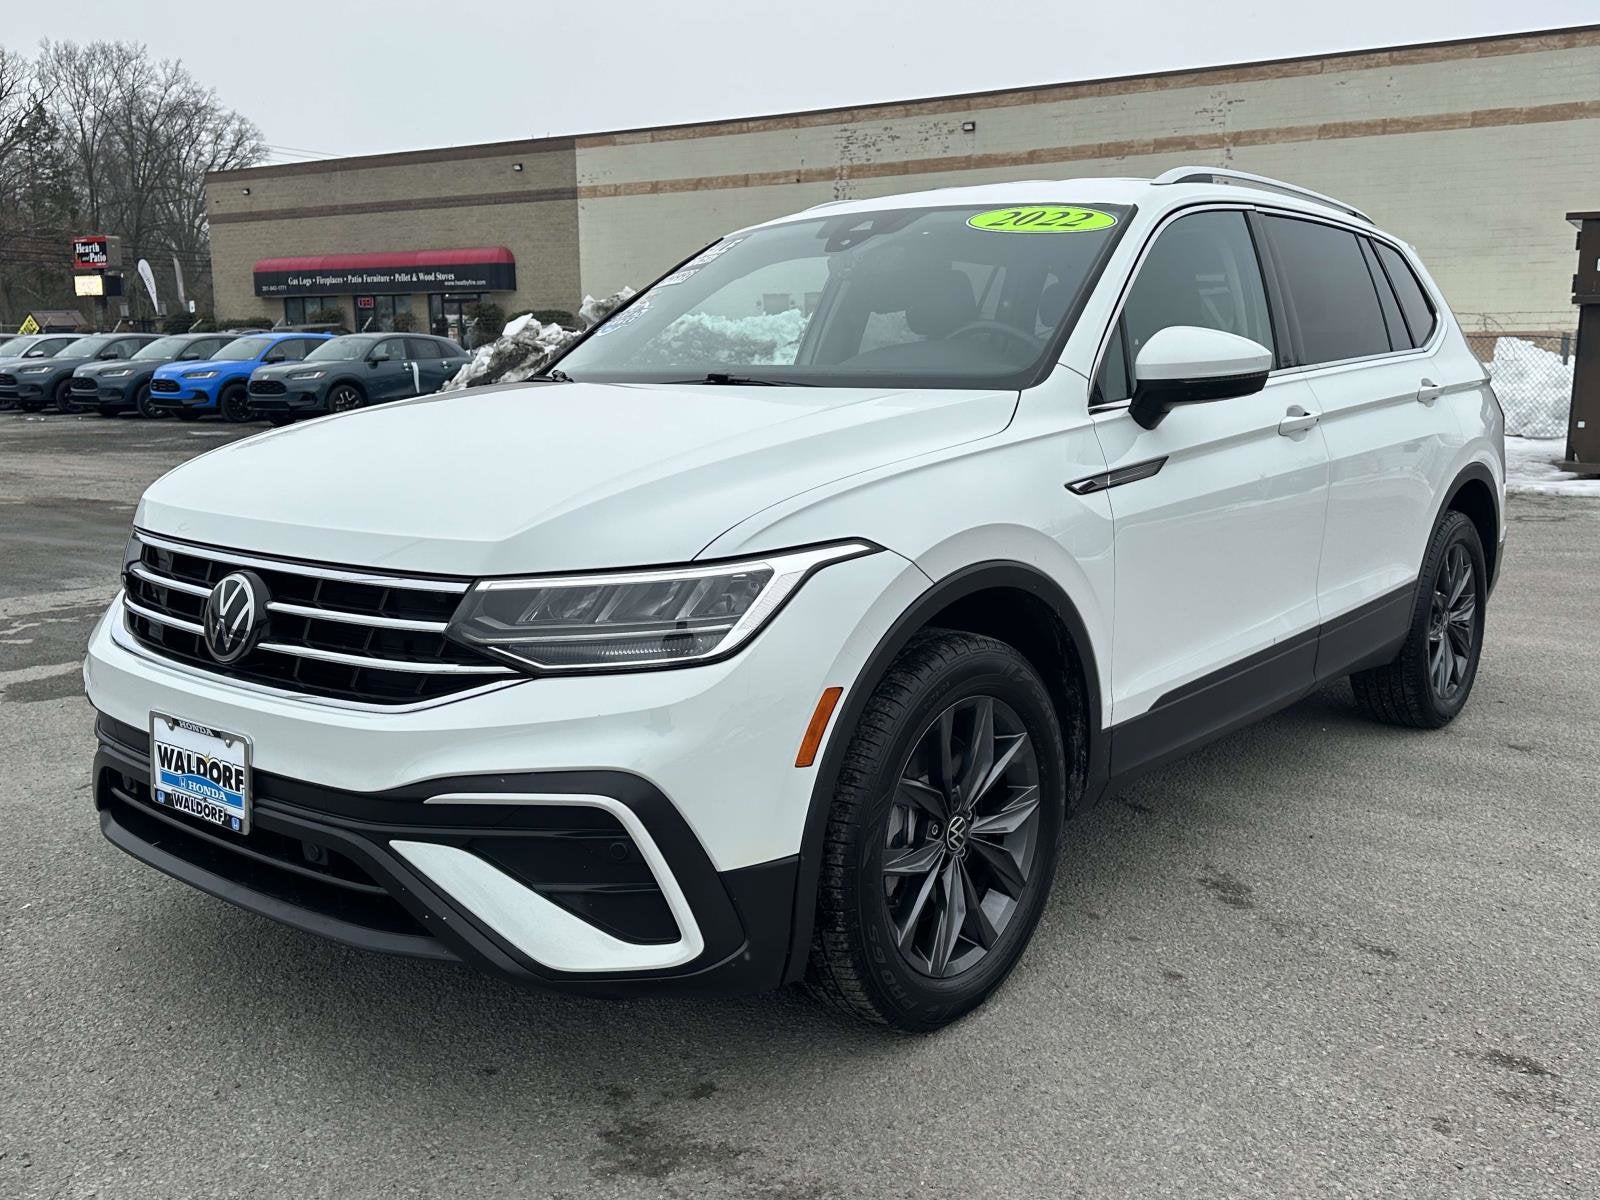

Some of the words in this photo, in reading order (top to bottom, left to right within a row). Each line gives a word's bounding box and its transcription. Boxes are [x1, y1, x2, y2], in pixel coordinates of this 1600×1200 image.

[986, 211, 1095, 227] 2022
[75, 242, 100, 253] Hearth
[90, 252, 107, 263] Patio
[288, 276, 298, 285] Gas
[299, 276, 311, 286] Logs
[316, 275, 343, 286] Fireplaces
[347, 274, 362, 283] Patio
[363, 273, 390, 283] Furniture
[395, 273, 411, 282] Pellet
[411, 273, 417, 281] &
[419, 272, 435, 281] Wood
[436, 271, 455, 280] Stoves
[178, 720, 214, 737] HONDA
[157, 745, 245, 793] WALDORF
[188, 780, 228, 802] HONDA
[173, 792, 225, 823] WALDORF
